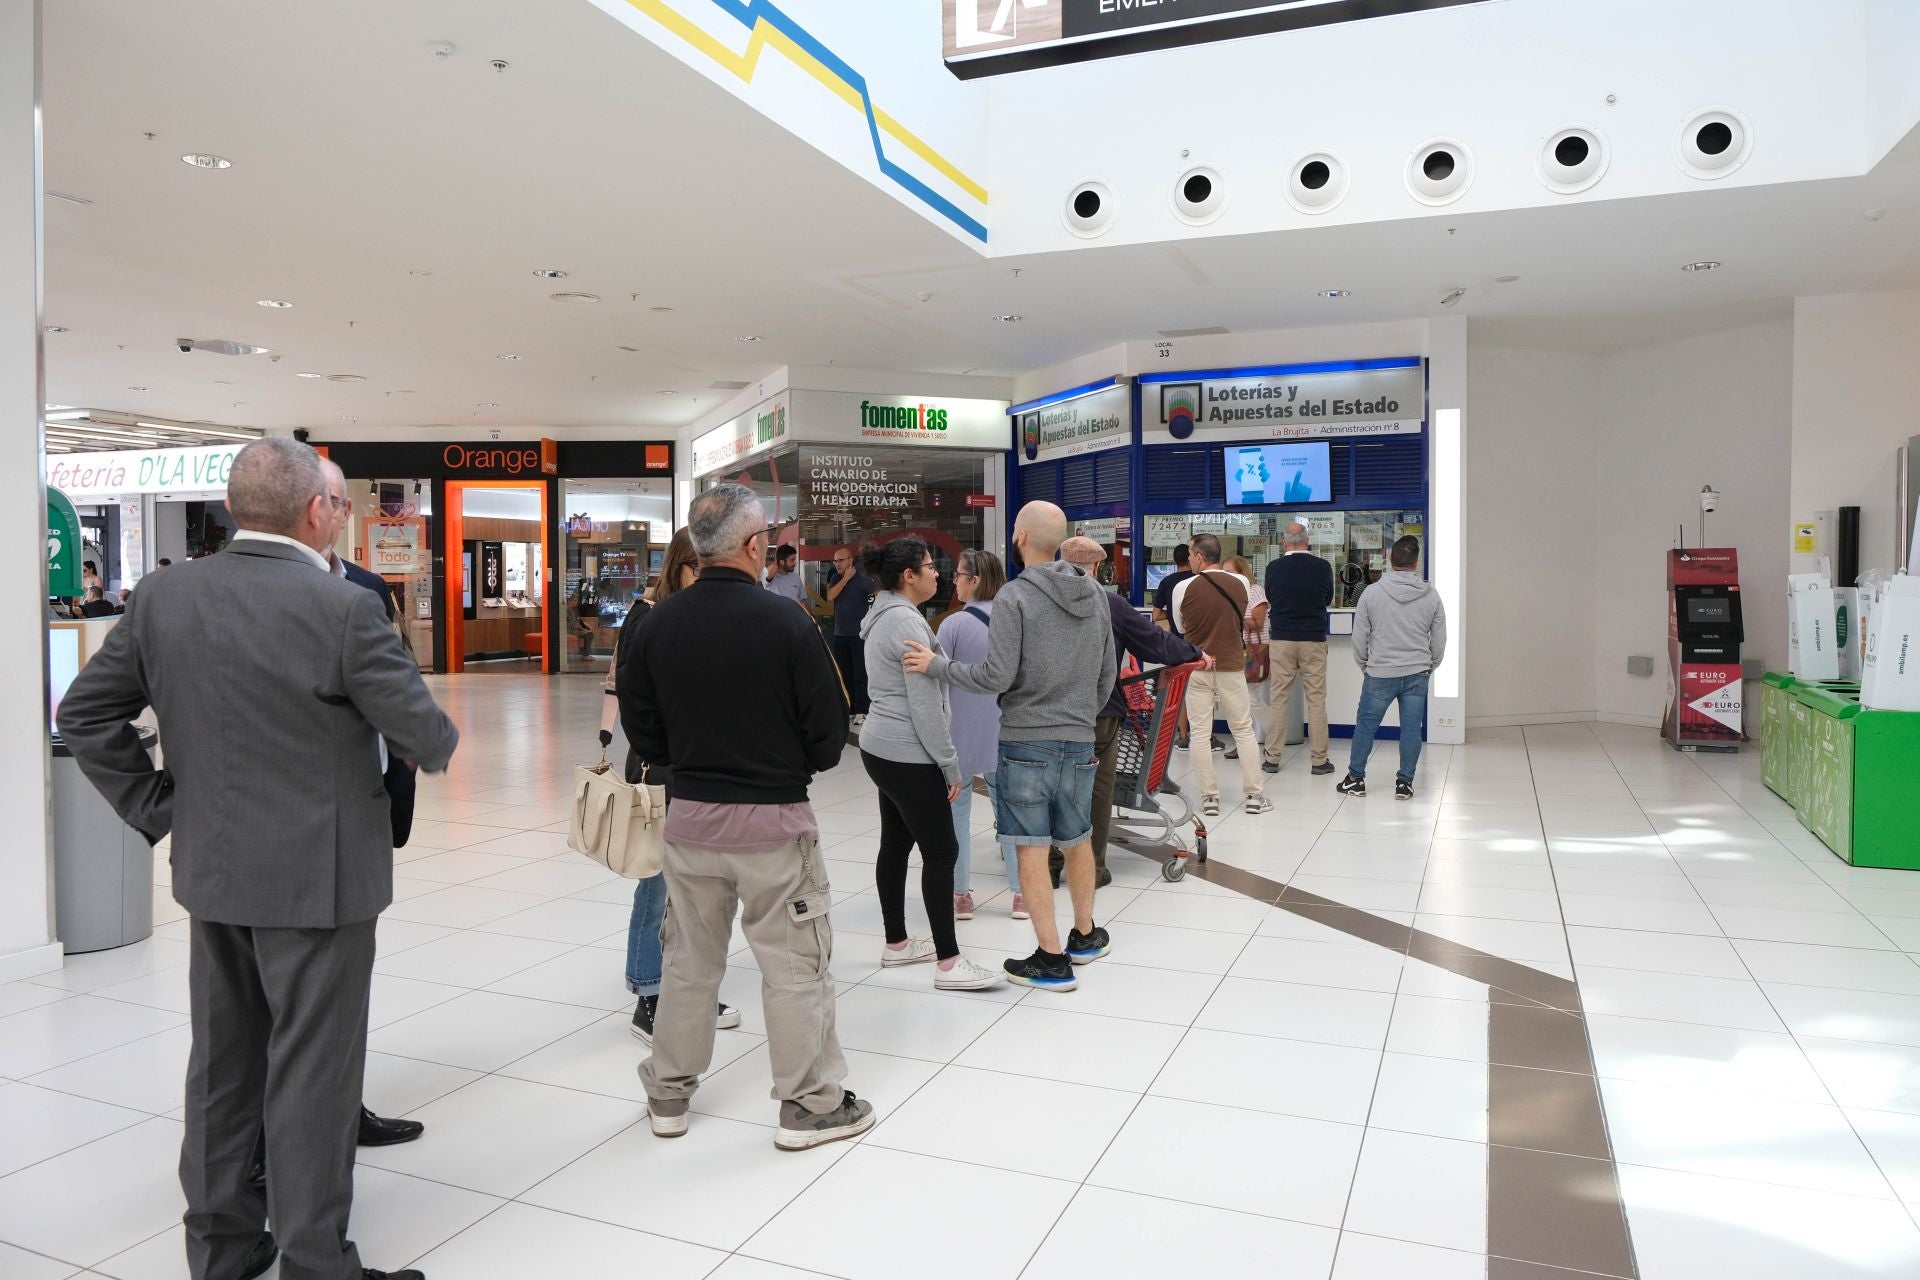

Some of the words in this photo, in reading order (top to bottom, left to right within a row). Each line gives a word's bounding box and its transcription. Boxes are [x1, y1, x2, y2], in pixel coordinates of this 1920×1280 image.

[1208, 383, 1282, 402] Loterías
[1288, 384, 1298, 402] y
[861, 400, 947, 430] fomentas
[1041, 408, 1072, 427] Loterías
[1073, 408, 1078, 423] y
[1208, 406, 1293, 424] Apuestas
[1299, 401, 1326, 417] del
[1332, 396, 1399, 416] Estado
[1042, 427, 1076, 445] Apuestas
[1077, 420, 1089, 436] del
[1091, 413, 1120, 433] Estado
[1272, 428, 1282, 436] La
[1283, 427, 1309, 438] Brujita
[1320, 423, 1382, 434] Administración
[443, 444, 538, 473] Orange
[811, 455, 873, 467] INSTITUTO
[46, 459, 126, 488] fetería
[194, 452, 234, 483] VEG
[811, 468, 869, 480] CANARIO
[872, 469, 887, 480] DE
[811, 494, 817, 505] Y
[821, 494, 909, 507] HEMOTERAPIA
[1151, 522, 1187, 531] 72472
[378, 551, 411, 562] Todo
[1899, 634, 1909, 675] ambilamp.es
